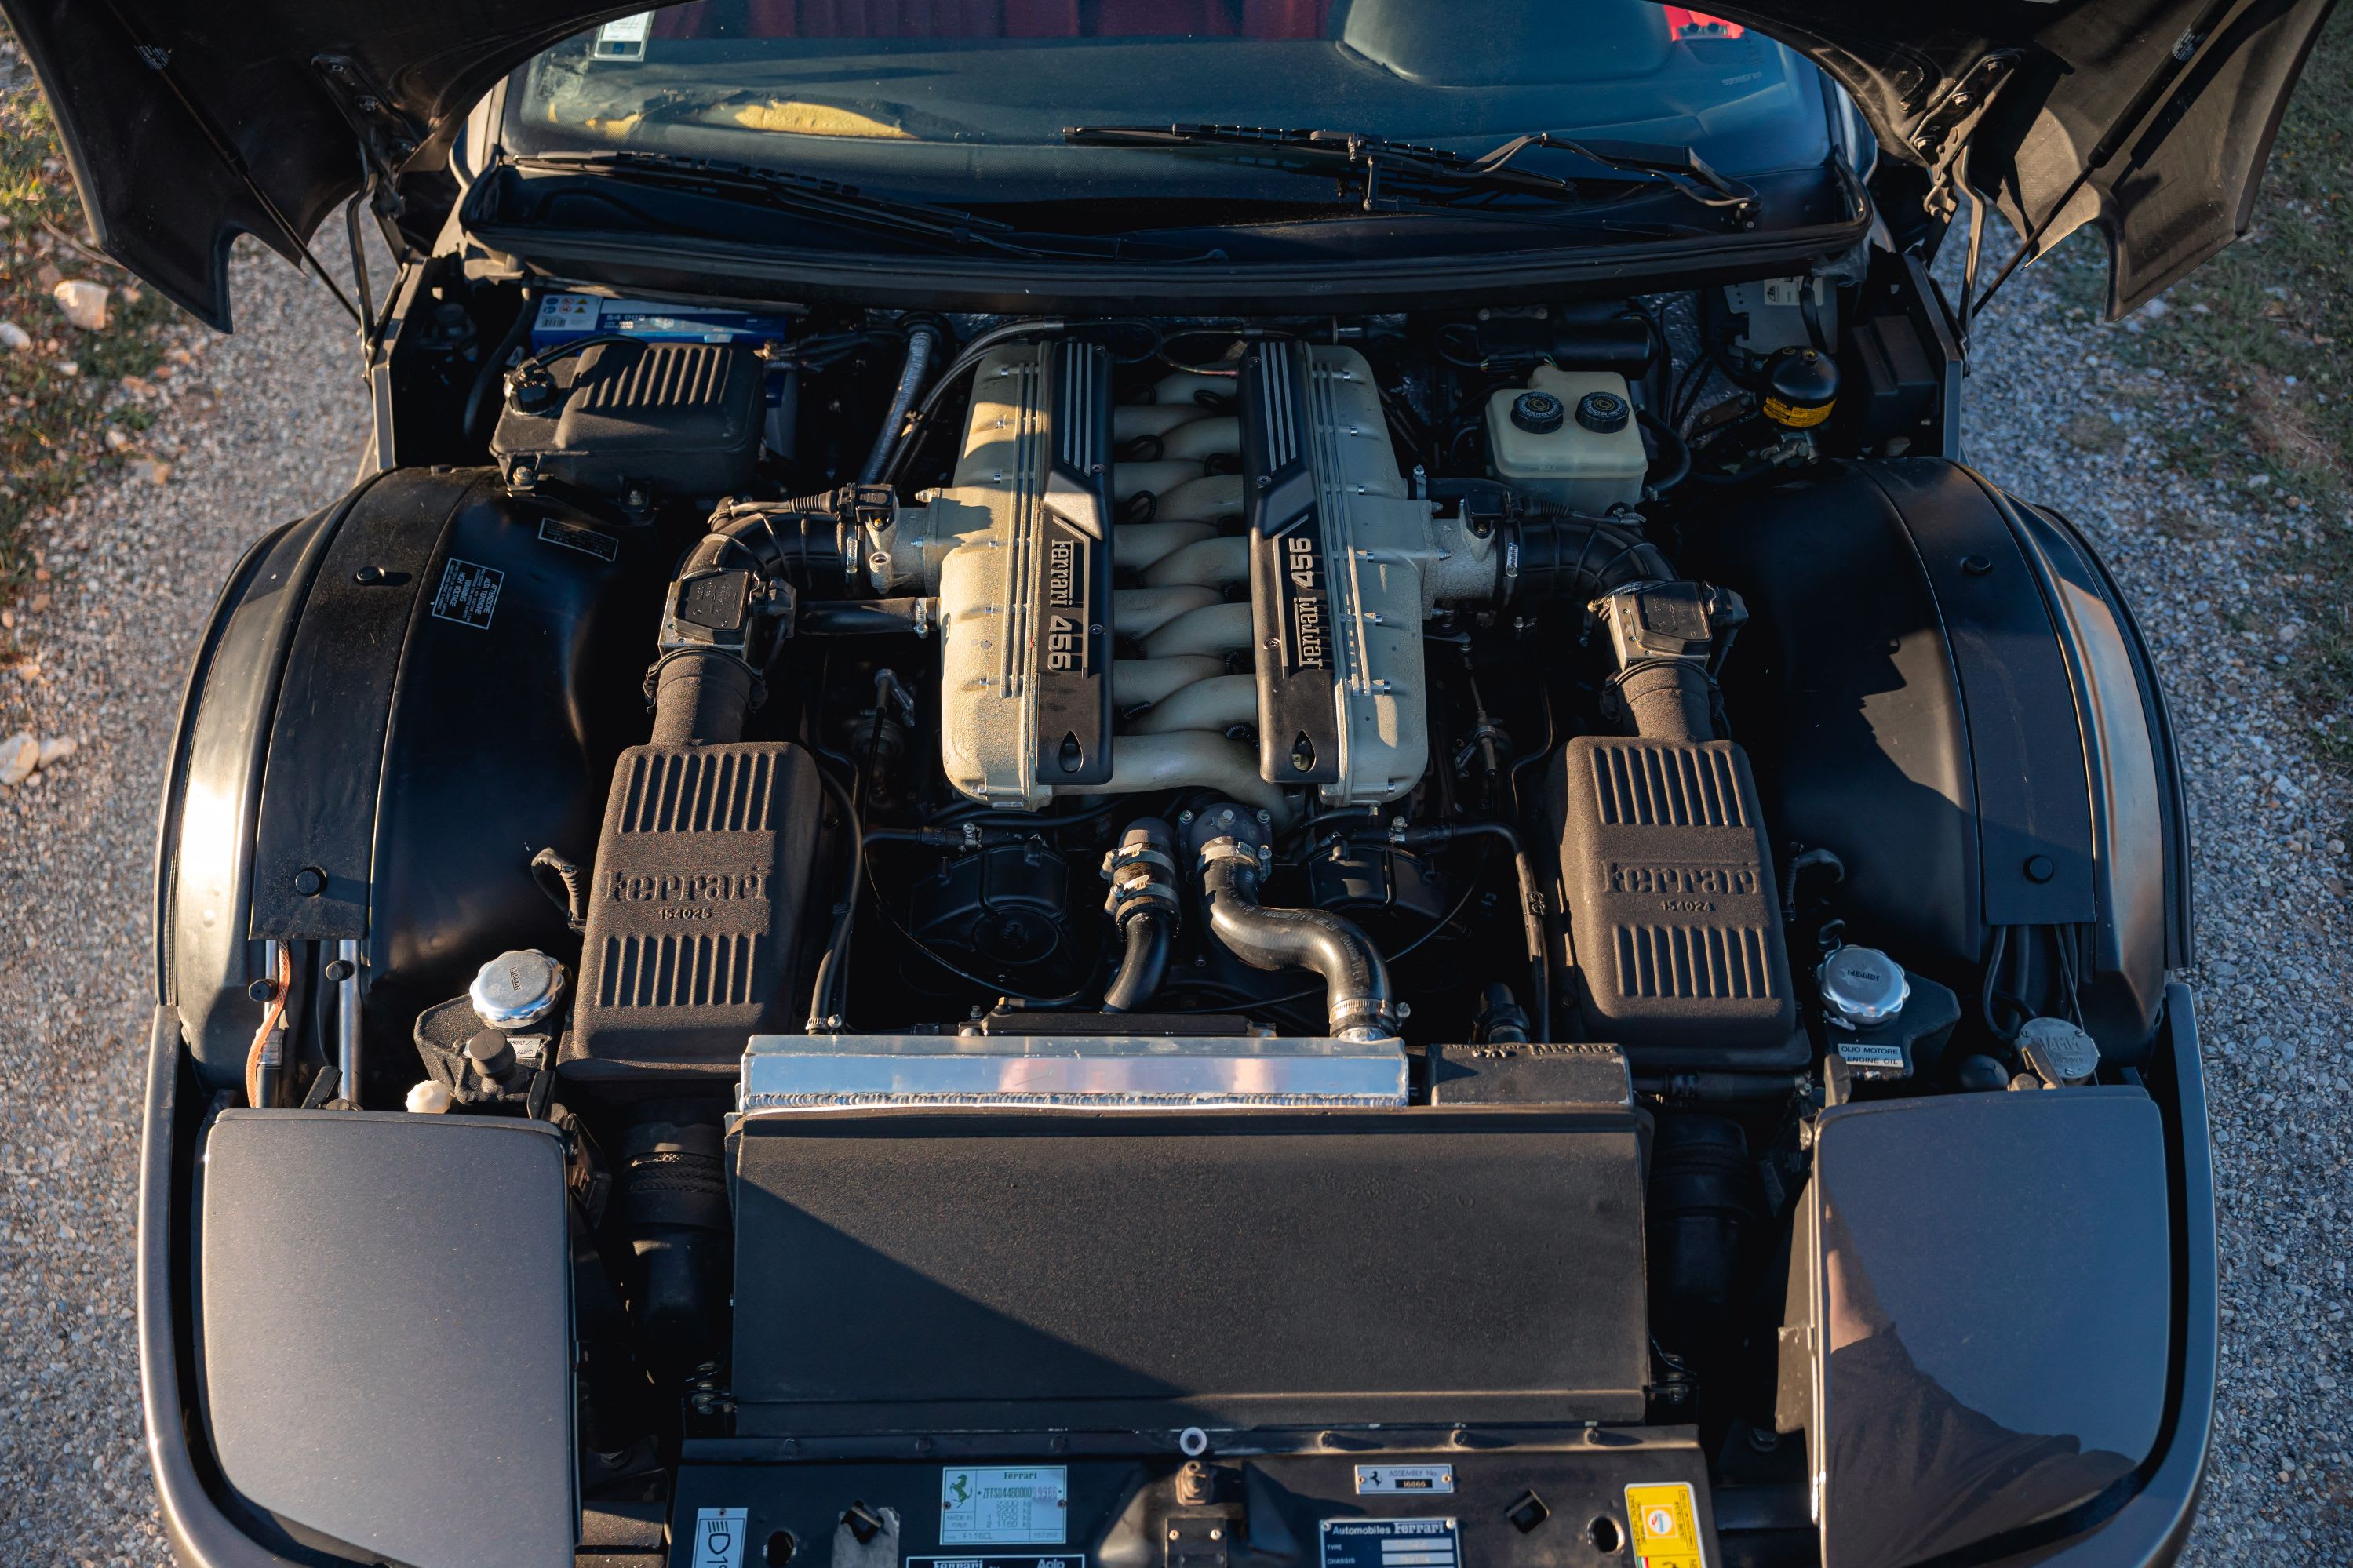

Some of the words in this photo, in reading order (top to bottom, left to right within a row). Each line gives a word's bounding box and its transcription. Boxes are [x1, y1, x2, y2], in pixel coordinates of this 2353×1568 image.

[1050, 539, 1074, 608] Ferrari
[1288, 537, 1314, 589] 456
[456, 571, 465, 584] HIGH
[459, 578, 472, 602] WARNING
[482, 577, 491, 589] ALTA
[448, 584, 461, 608] VOLTAGE
[474, 589, 487, 615] TENSIONE
[483, 583, 497, 613] ATTENZIONE
[1048, 614, 1073, 670] 456
[1294, 596, 1323, 668] Ferrari
[603, 866, 773, 902] Ferrari
[1601, 861, 1764, 895] Ferrari
[1003, 1472, 1036, 1480] Ferrari
[1332, 1526, 1391, 1535] Automobiles
[1393, 1522, 1444, 1533] Ferrari
